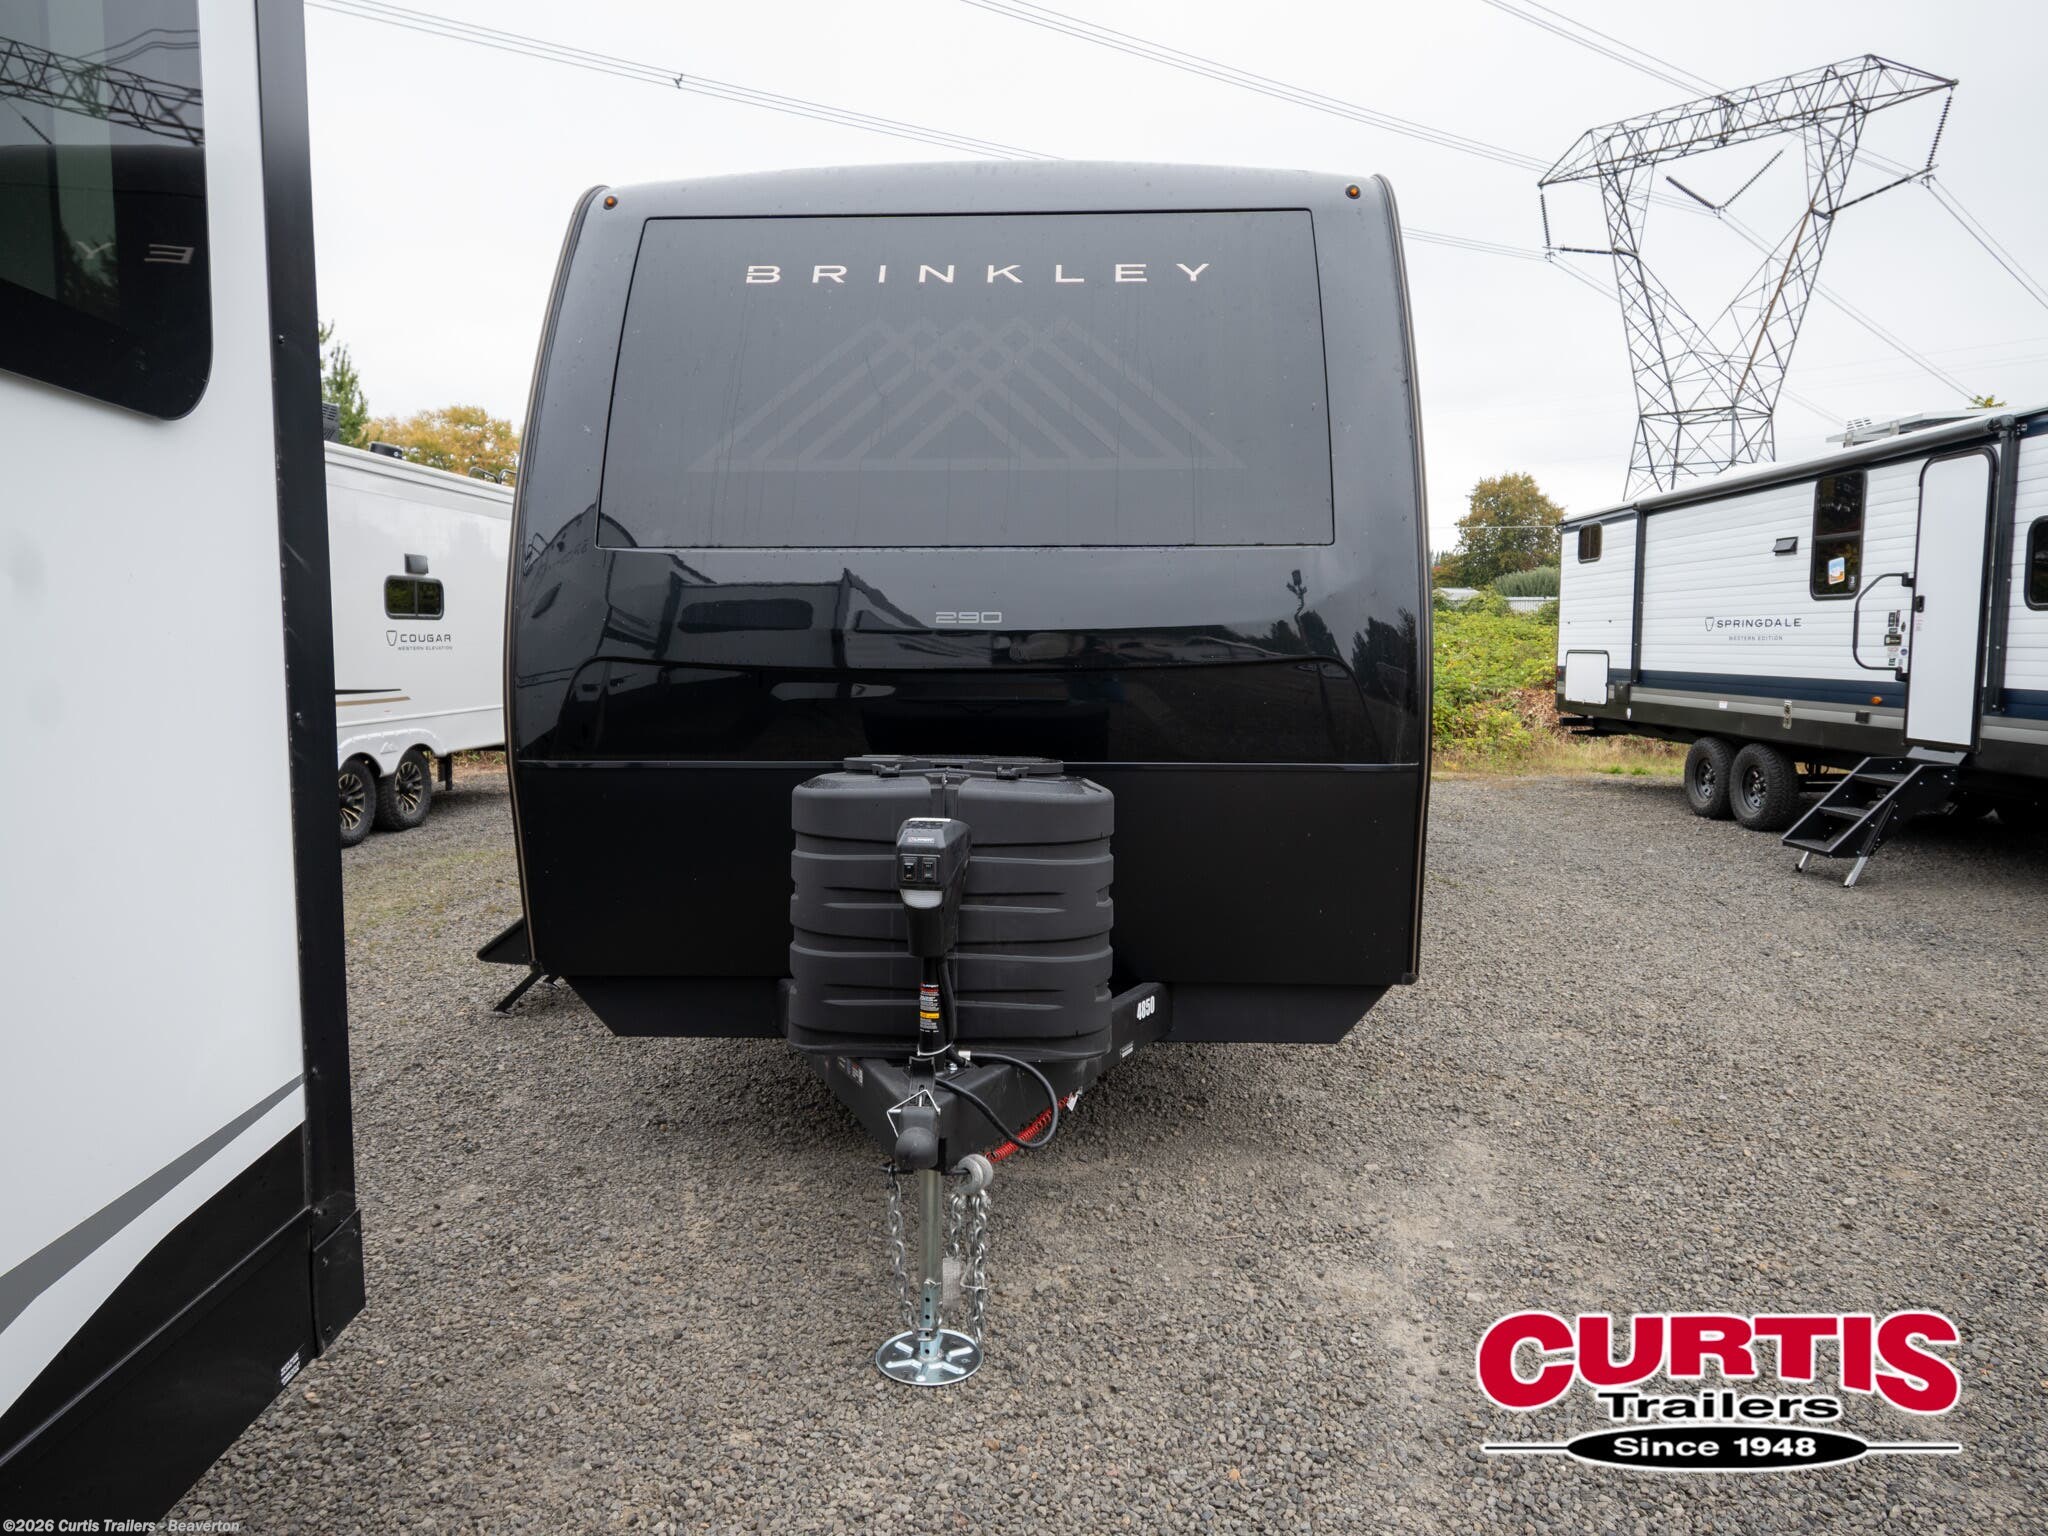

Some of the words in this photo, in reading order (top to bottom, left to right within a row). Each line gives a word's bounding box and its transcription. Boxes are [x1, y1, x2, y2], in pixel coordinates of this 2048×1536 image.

[745, 263, 1210, 284] BRINKLEY
[935, 611, 1002, 624] 290
[1716, 618, 1801, 628] SPRINGDALE
[400, 633, 451, 642] COUGAR
[1136, 995, 1155, 1020] 4850
